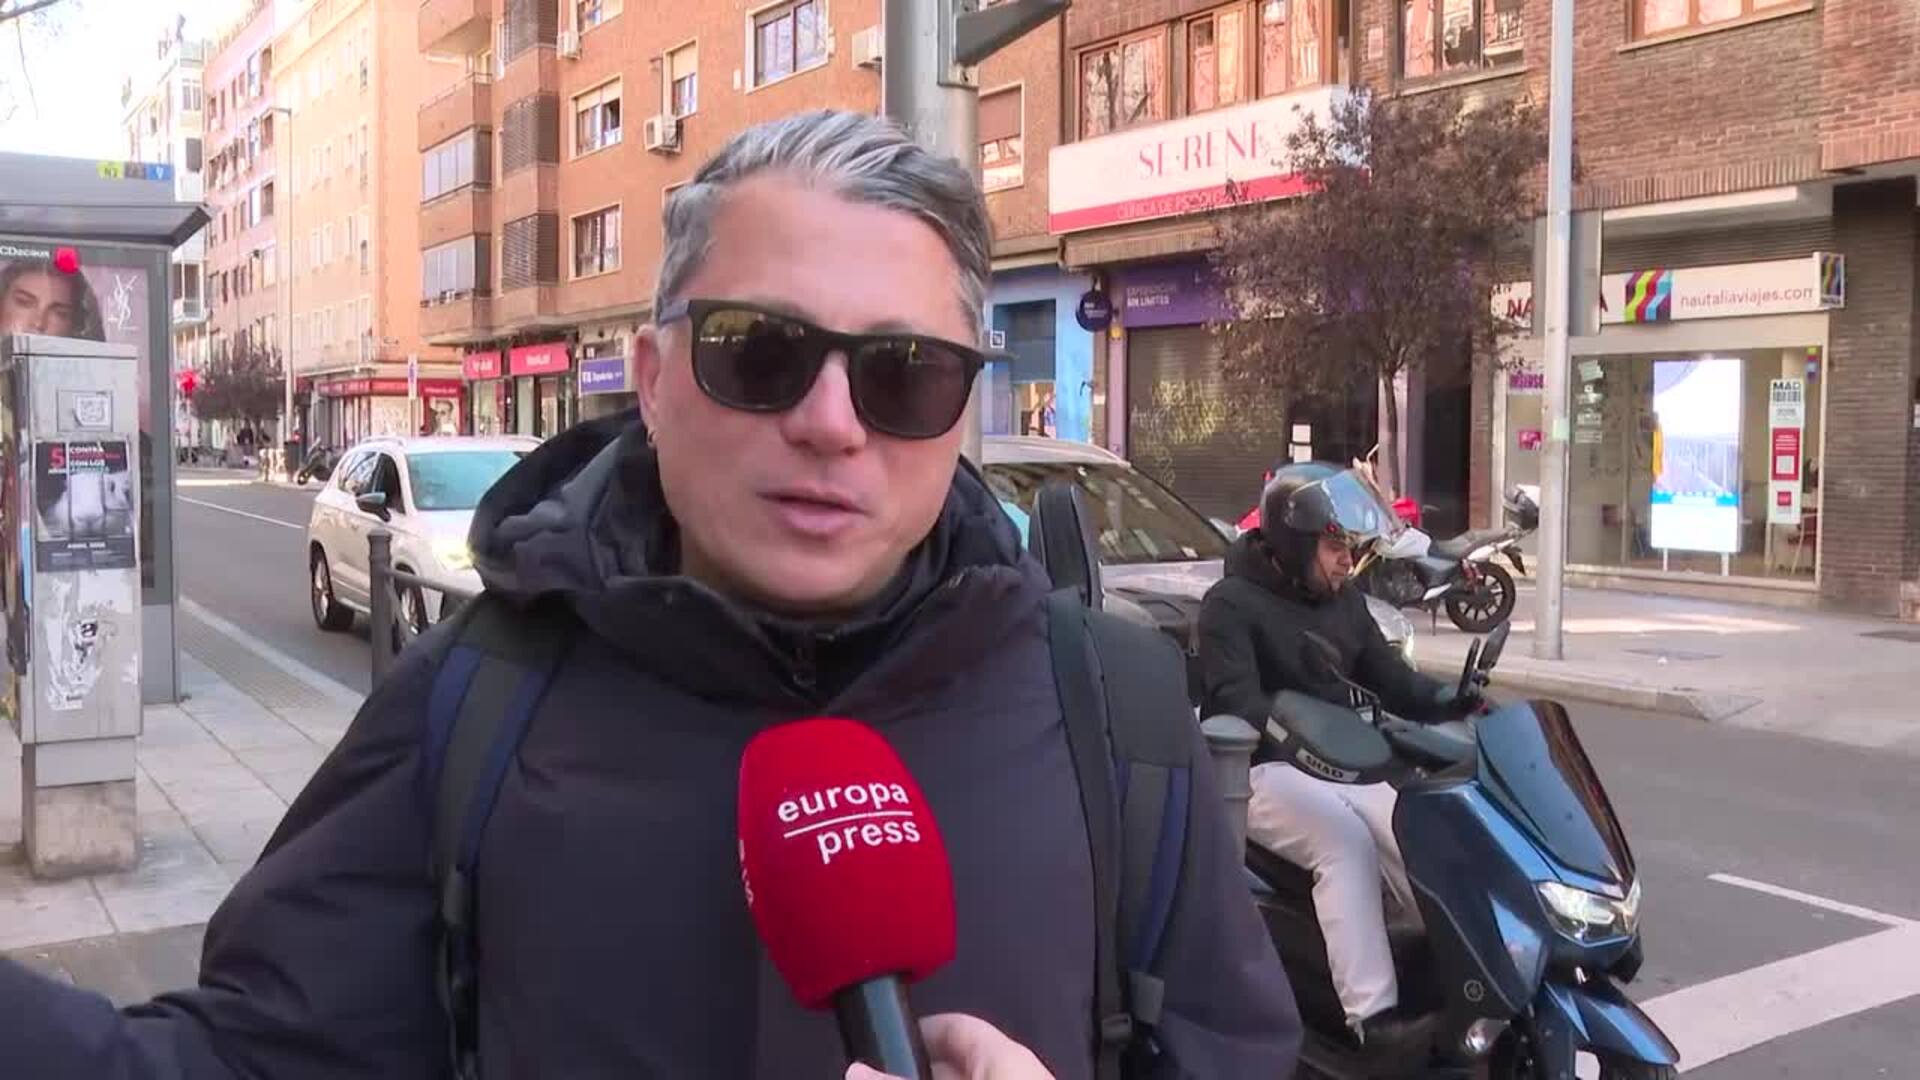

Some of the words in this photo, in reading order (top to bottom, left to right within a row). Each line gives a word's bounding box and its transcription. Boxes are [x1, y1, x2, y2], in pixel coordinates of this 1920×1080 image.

[1305, 754, 1344, 778] SHAD
[777, 782, 910, 822] europa
[816, 820, 921, 865] press
